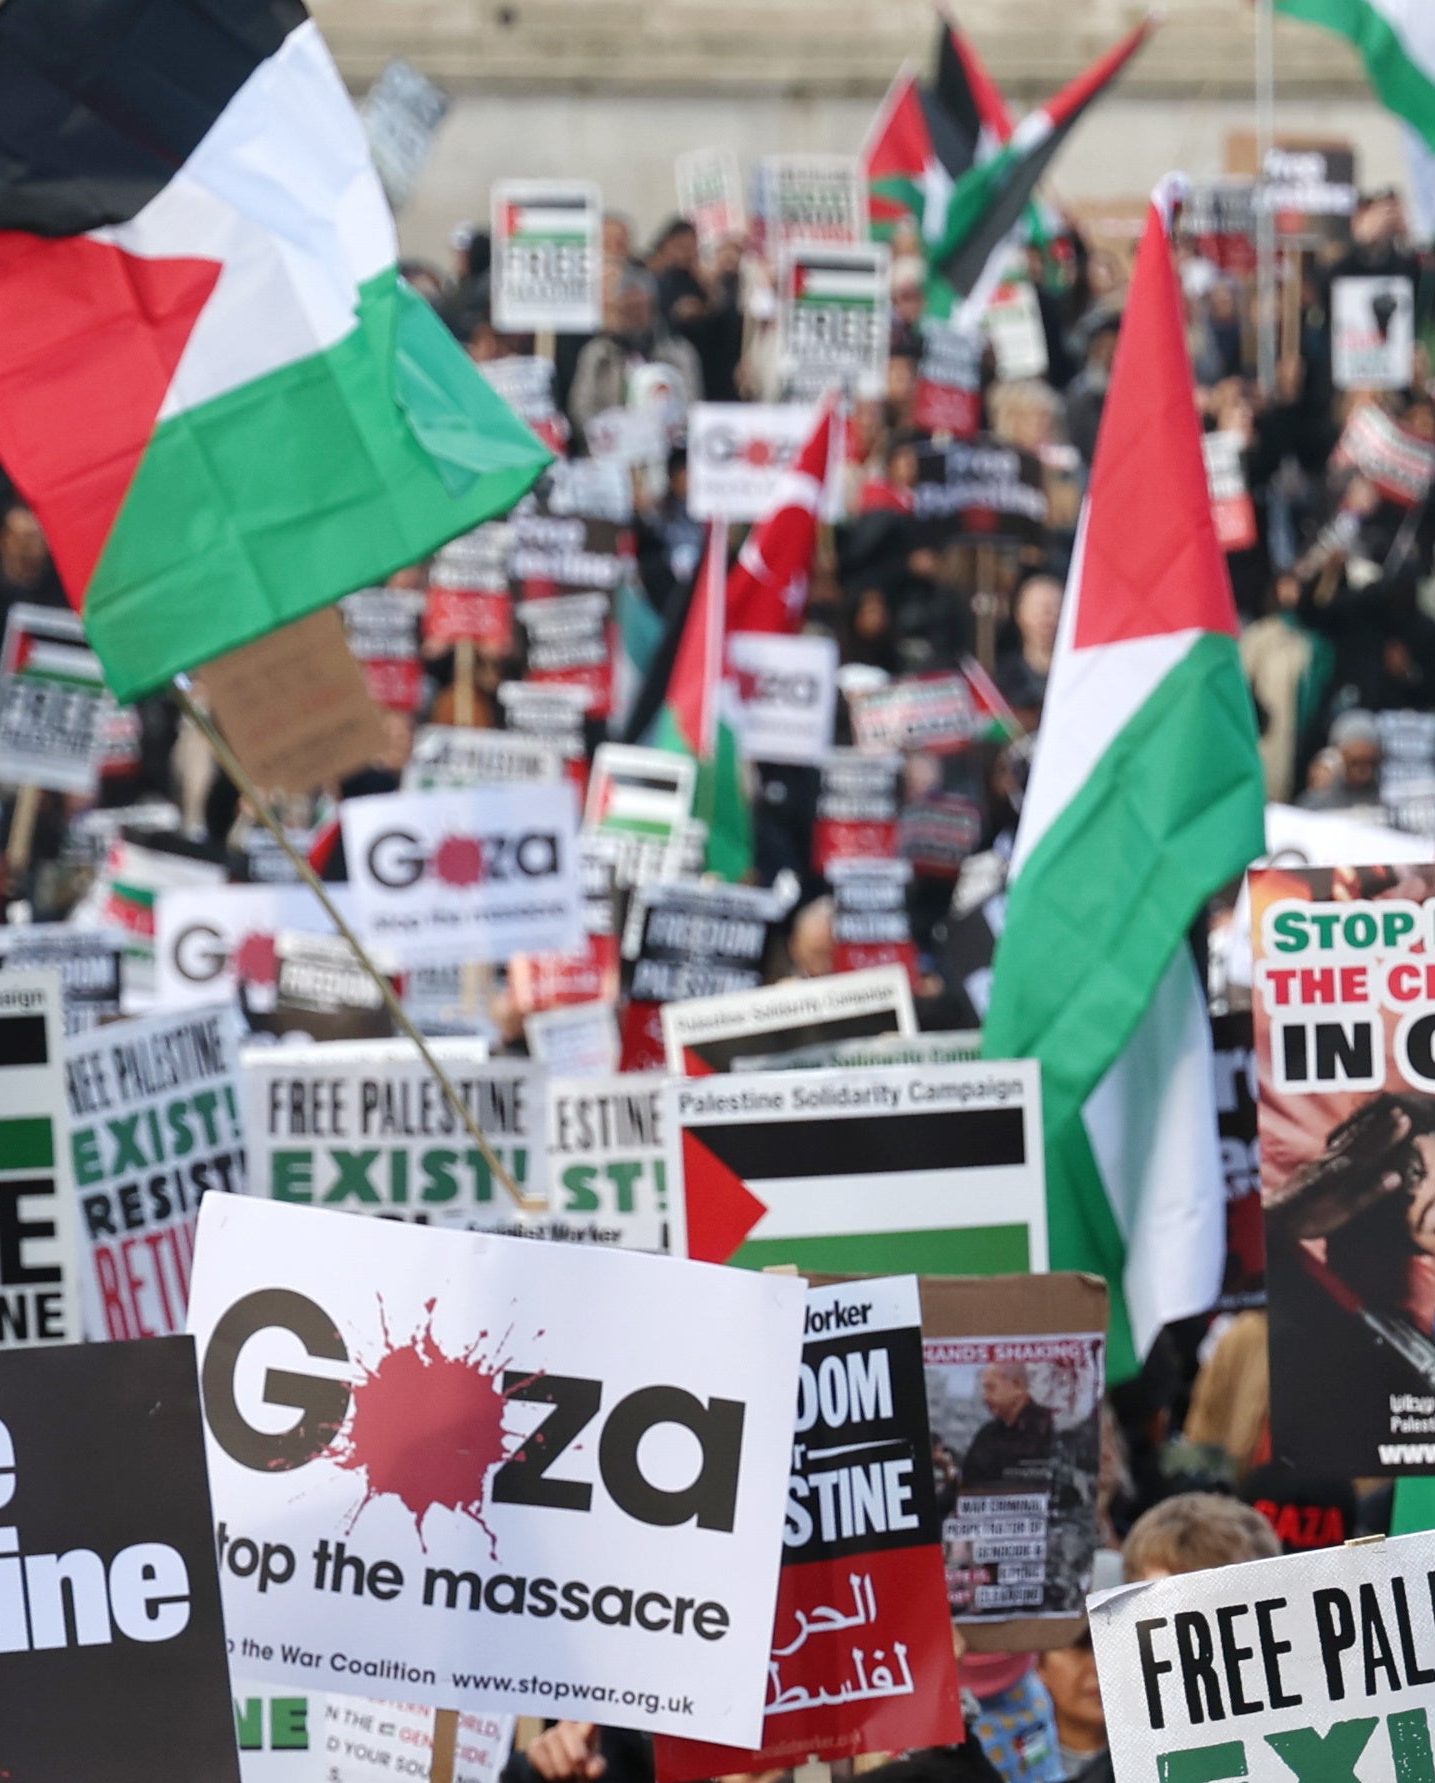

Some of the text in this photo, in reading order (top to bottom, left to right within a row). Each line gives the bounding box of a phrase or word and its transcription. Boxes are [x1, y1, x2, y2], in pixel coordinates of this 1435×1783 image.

[368, 830, 560, 889] Gza
[1273, 911, 1414, 953] STOP
[1265, 966, 1369, 1005] THE
[1283, 1022, 1373, 1082] IN
[269, 1078, 345, 1137] FREE
[678, 1076, 1024, 1116] Palestine Solidarity Campaign
[71, 1085, 243, 1187] EXIST!
[201, 1286, 747, 1534] Gza
[218, 1522, 731, 1643] top the massacre
[240, 1638, 273, 1663] the
[280, 1644, 323, 1670] War
[330, 1652, 437, 1687] Coalition
[451, 1669, 695, 1718] www.stopwar.org.uk
[1135, 1594, 1302, 1729] FREE
